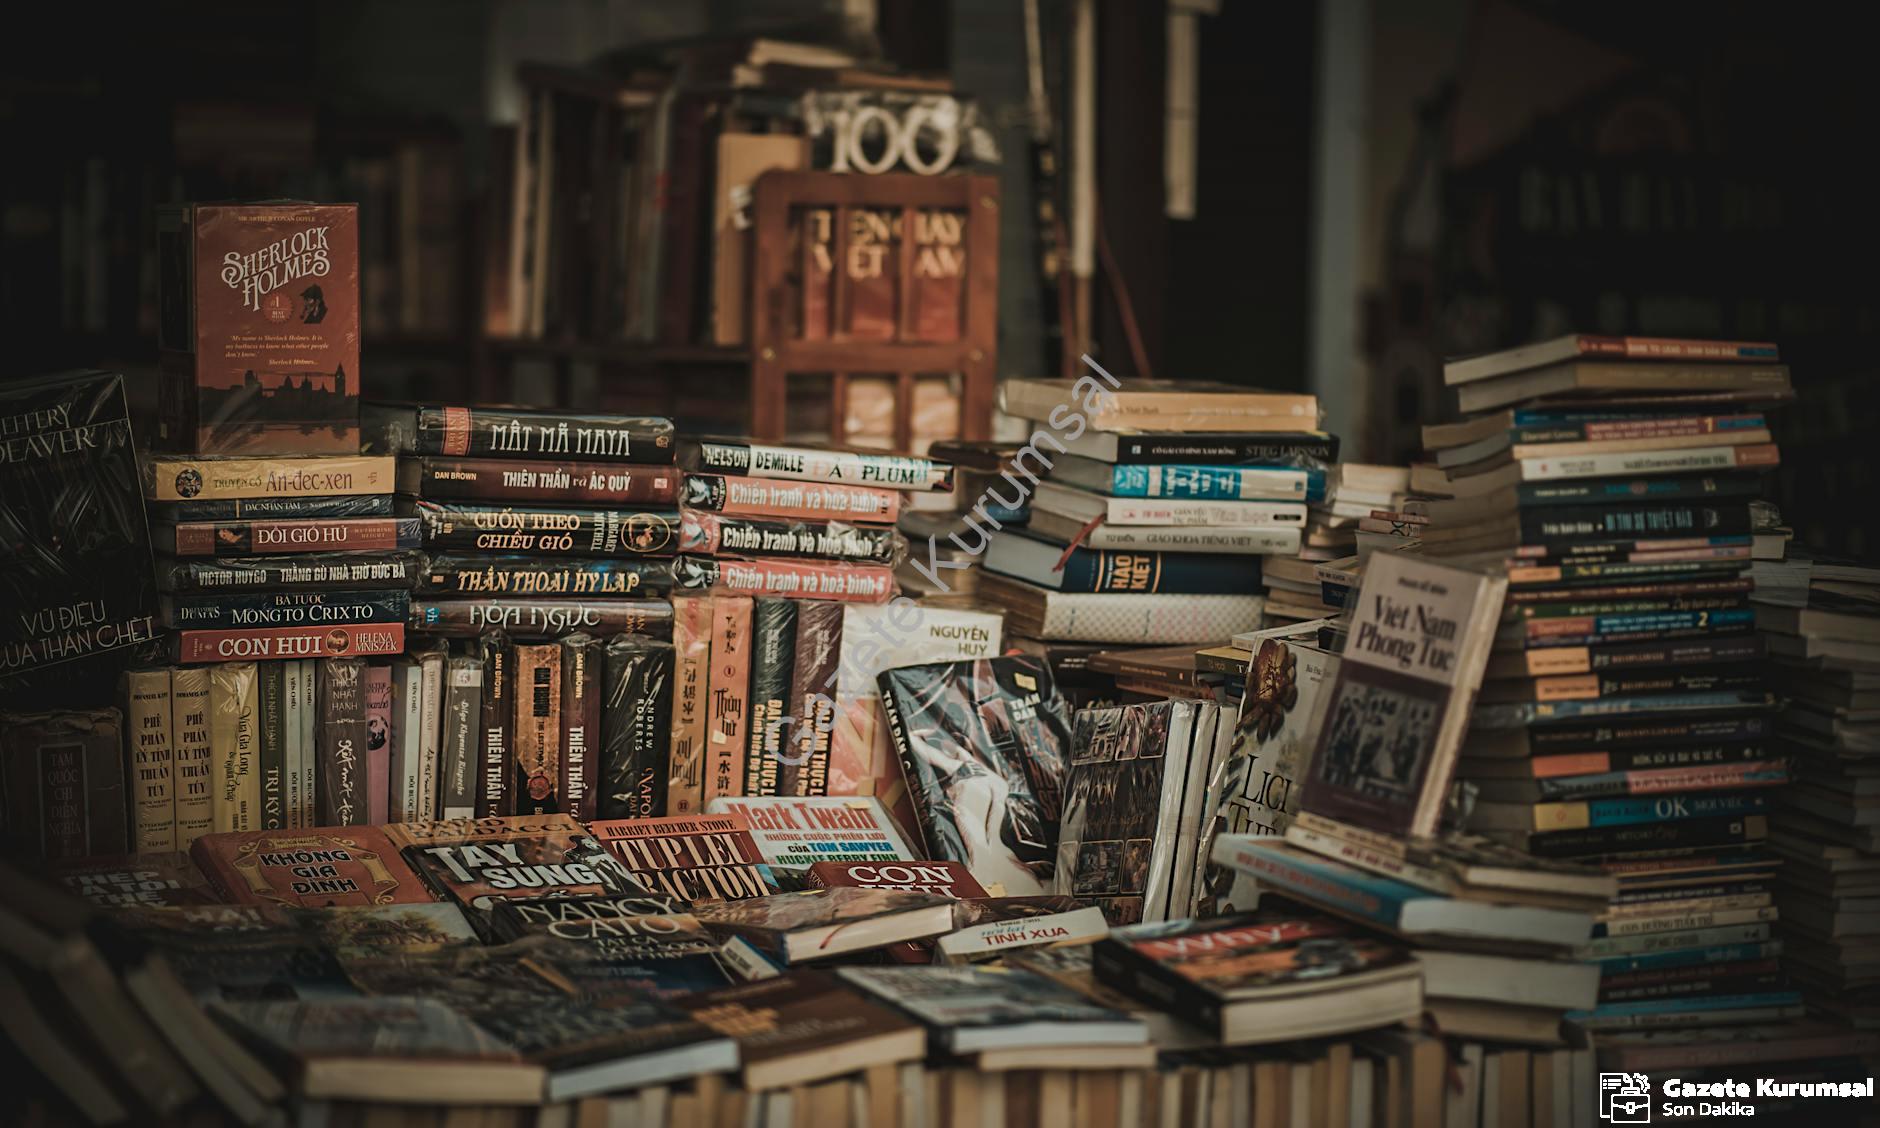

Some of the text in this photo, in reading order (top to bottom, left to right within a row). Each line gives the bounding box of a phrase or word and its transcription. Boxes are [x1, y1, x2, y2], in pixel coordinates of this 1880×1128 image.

[221, 226, 330, 289] SHERLOCK
[242, 249, 331, 313] HOLMES
[0, 402, 72, 436] EFFERY
[538, 422, 569, 453] MÃ
[575, 428, 631, 456] MAYA
[704, 447, 916, 484] NELSON DEMILLE PLUM
[434, 471, 449, 480] DAN
[450, 471, 477, 480] BROWN
[503, 468, 537, 488] THIÊN
[539, 467, 570, 489] THẦN
[589, 471, 605, 490] ÁC
[730, 482, 767, 504] Chiến
[769, 486, 803, 508] tranh
[473, 508, 581, 530] CUỐN THEO
[289, 525, 320, 543] GIÓ
[538, 534, 573, 551] GIÓ
[723, 526, 761, 549] Chiến
[763, 534, 798, 552] tranh
[199, 570, 233, 586] VICTOR
[234, 569, 267, 585] HUYGO
[329, 565, 350, 581] NHÀ
[727, 567, 765, 590] Chiến
[766, 570, 801, 592] tranh
[802, 572, 819, 592] và
[308, 605, 349, 622] CRIX
[1411, 604, 1457, 641] Nam
[1697, 611, 1709, 627] 2
[218, 637, 268, 657] CON
[355, 632, 393, 643] HELENA
[355, 640, 397, 652] MNISZEK
[958, 642, 987, 656] HUY
[1355, 622, 1416, 669] Phong
[331, 678, 358, 687] THÍCH
[494, 653, 502, 699] DAN BROWN
[575, 653, 583, 699] DAN BROWN
[634, 698, 645, 752] ROBERTS
[487, 726, 506, 800] THIÊN THẦN
[568, 726, 589, 800] THIÊN THẦN
[737, 803, 880, 830] Mark Twain
[1654, 797, 1690, 819] OK
[606, 819, 738, 837] HARRIET BEECHER STOWE
[260, 849, 353, 867] KHÔNG
[808, 842, 840, 852] TOM
[839, 842, 894, 852] SAWYER
[291, 864, 338, 879] GIA
[424, 843, 525, 883] TAY
[848, 865, 955, 884] CON
[291, 878, 360, 896] ĐÌNH
[514, 896, 682, 923] NANCY
[547, 917, 681, 940] CATO
